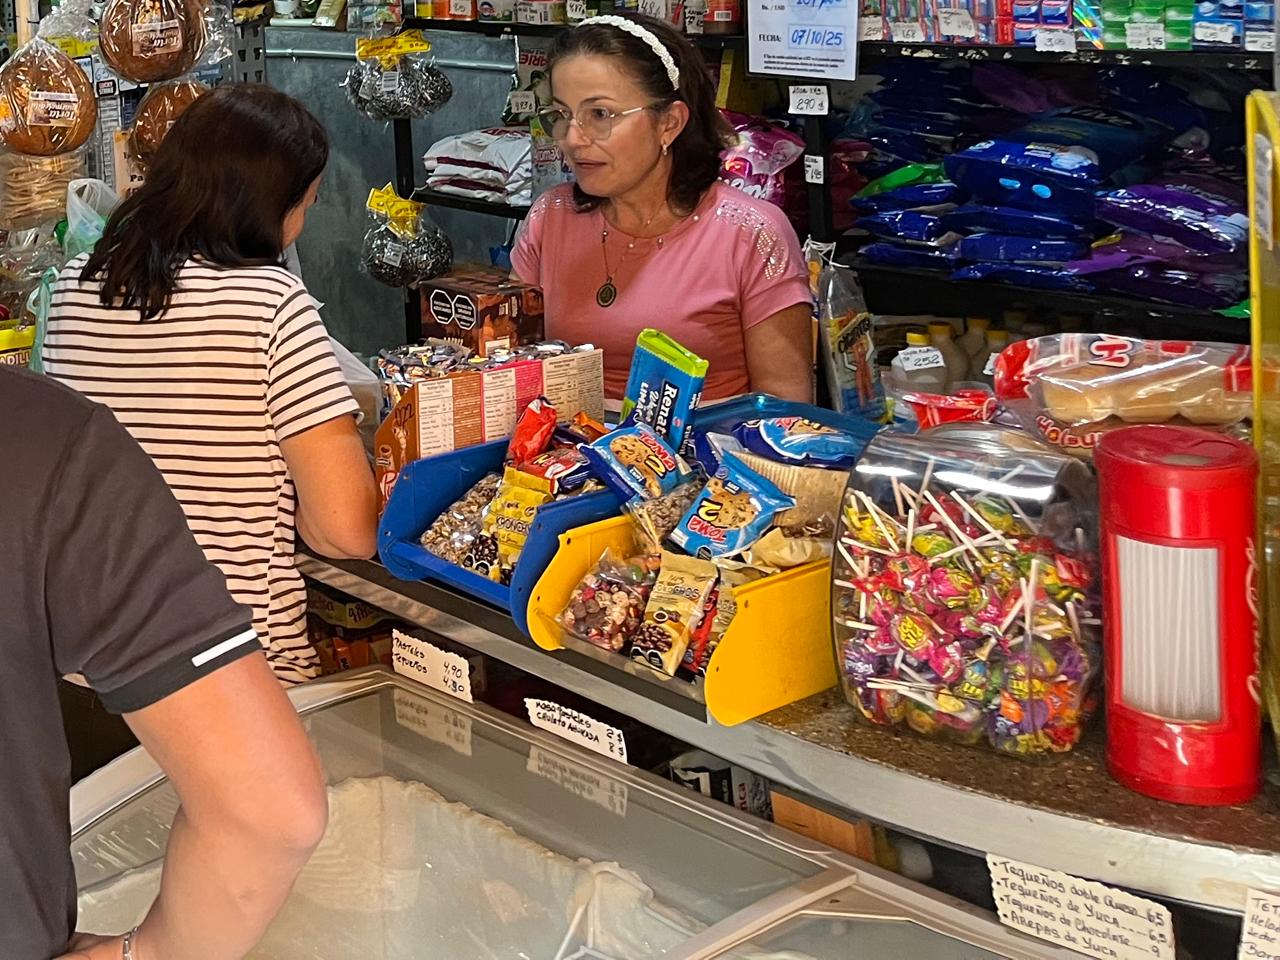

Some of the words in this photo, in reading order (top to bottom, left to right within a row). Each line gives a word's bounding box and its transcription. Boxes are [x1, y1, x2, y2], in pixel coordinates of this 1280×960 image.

[758, 33, 782, 42] FECHA:
[791, 28, 844, 47] 07/10/25
[519, 53, 550, 67] ARIE
[48, 110, 76, 121] Torta
